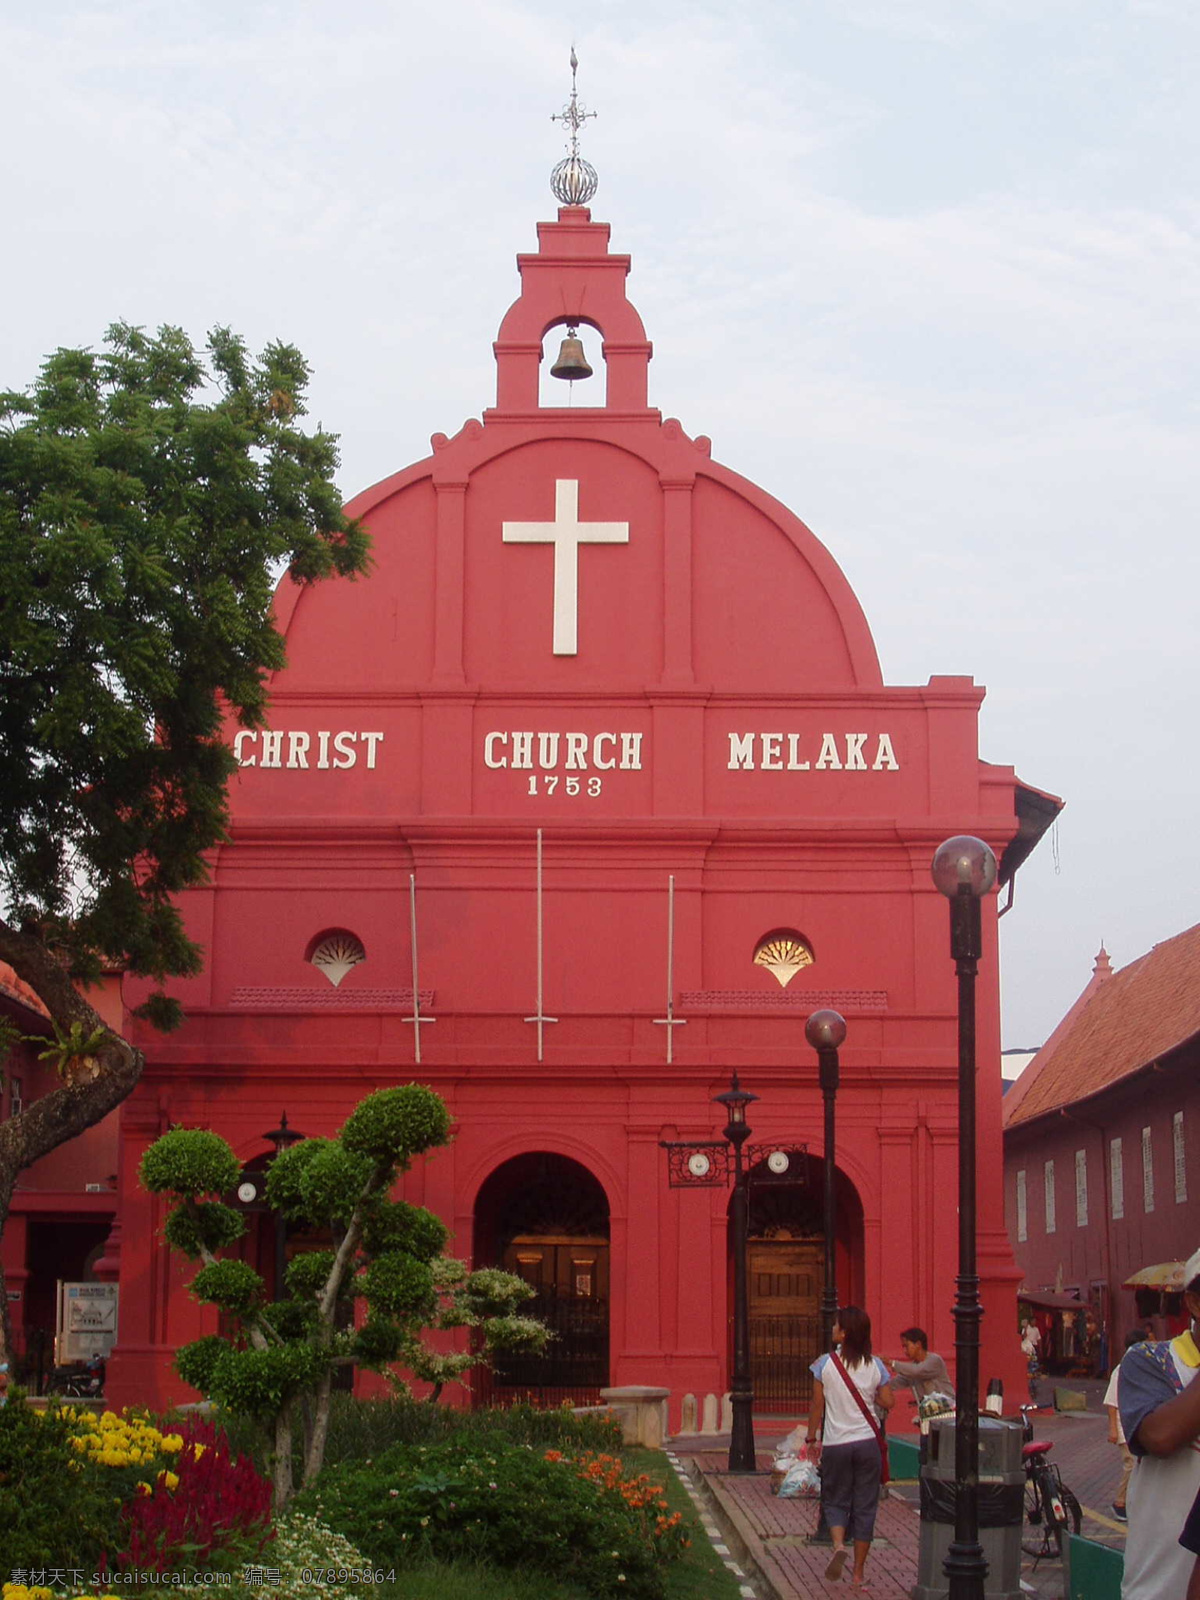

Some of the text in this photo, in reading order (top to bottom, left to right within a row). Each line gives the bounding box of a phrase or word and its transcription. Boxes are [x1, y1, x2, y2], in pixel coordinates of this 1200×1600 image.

[234, 730, 900, 771] CHRIST CHURCH MELAKA
[528, 775, 602, 797] 1753
